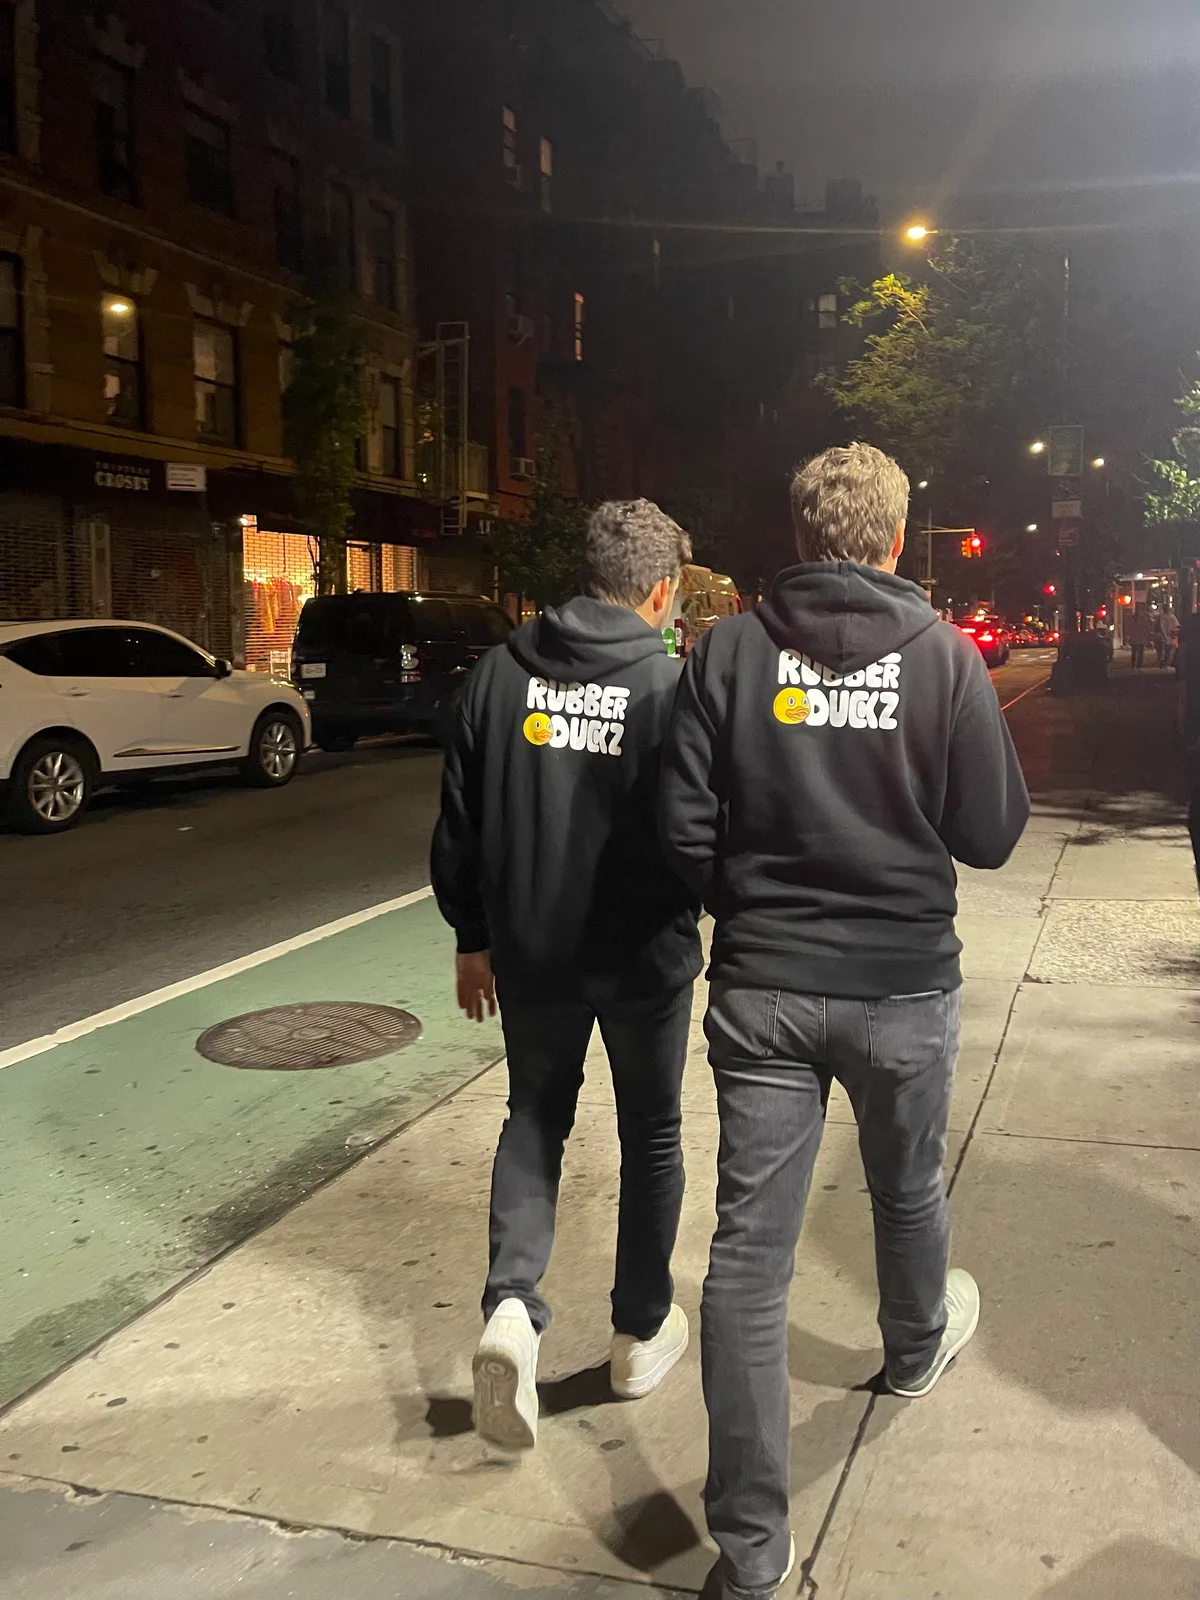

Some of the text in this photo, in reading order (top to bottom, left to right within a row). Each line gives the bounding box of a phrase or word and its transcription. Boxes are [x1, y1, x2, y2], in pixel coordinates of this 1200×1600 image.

[527, 676, 630, 720] RUBBER
[805, 688, 900, 730] DUCKZ
[549, 714, 625, 756] DUCKZ
